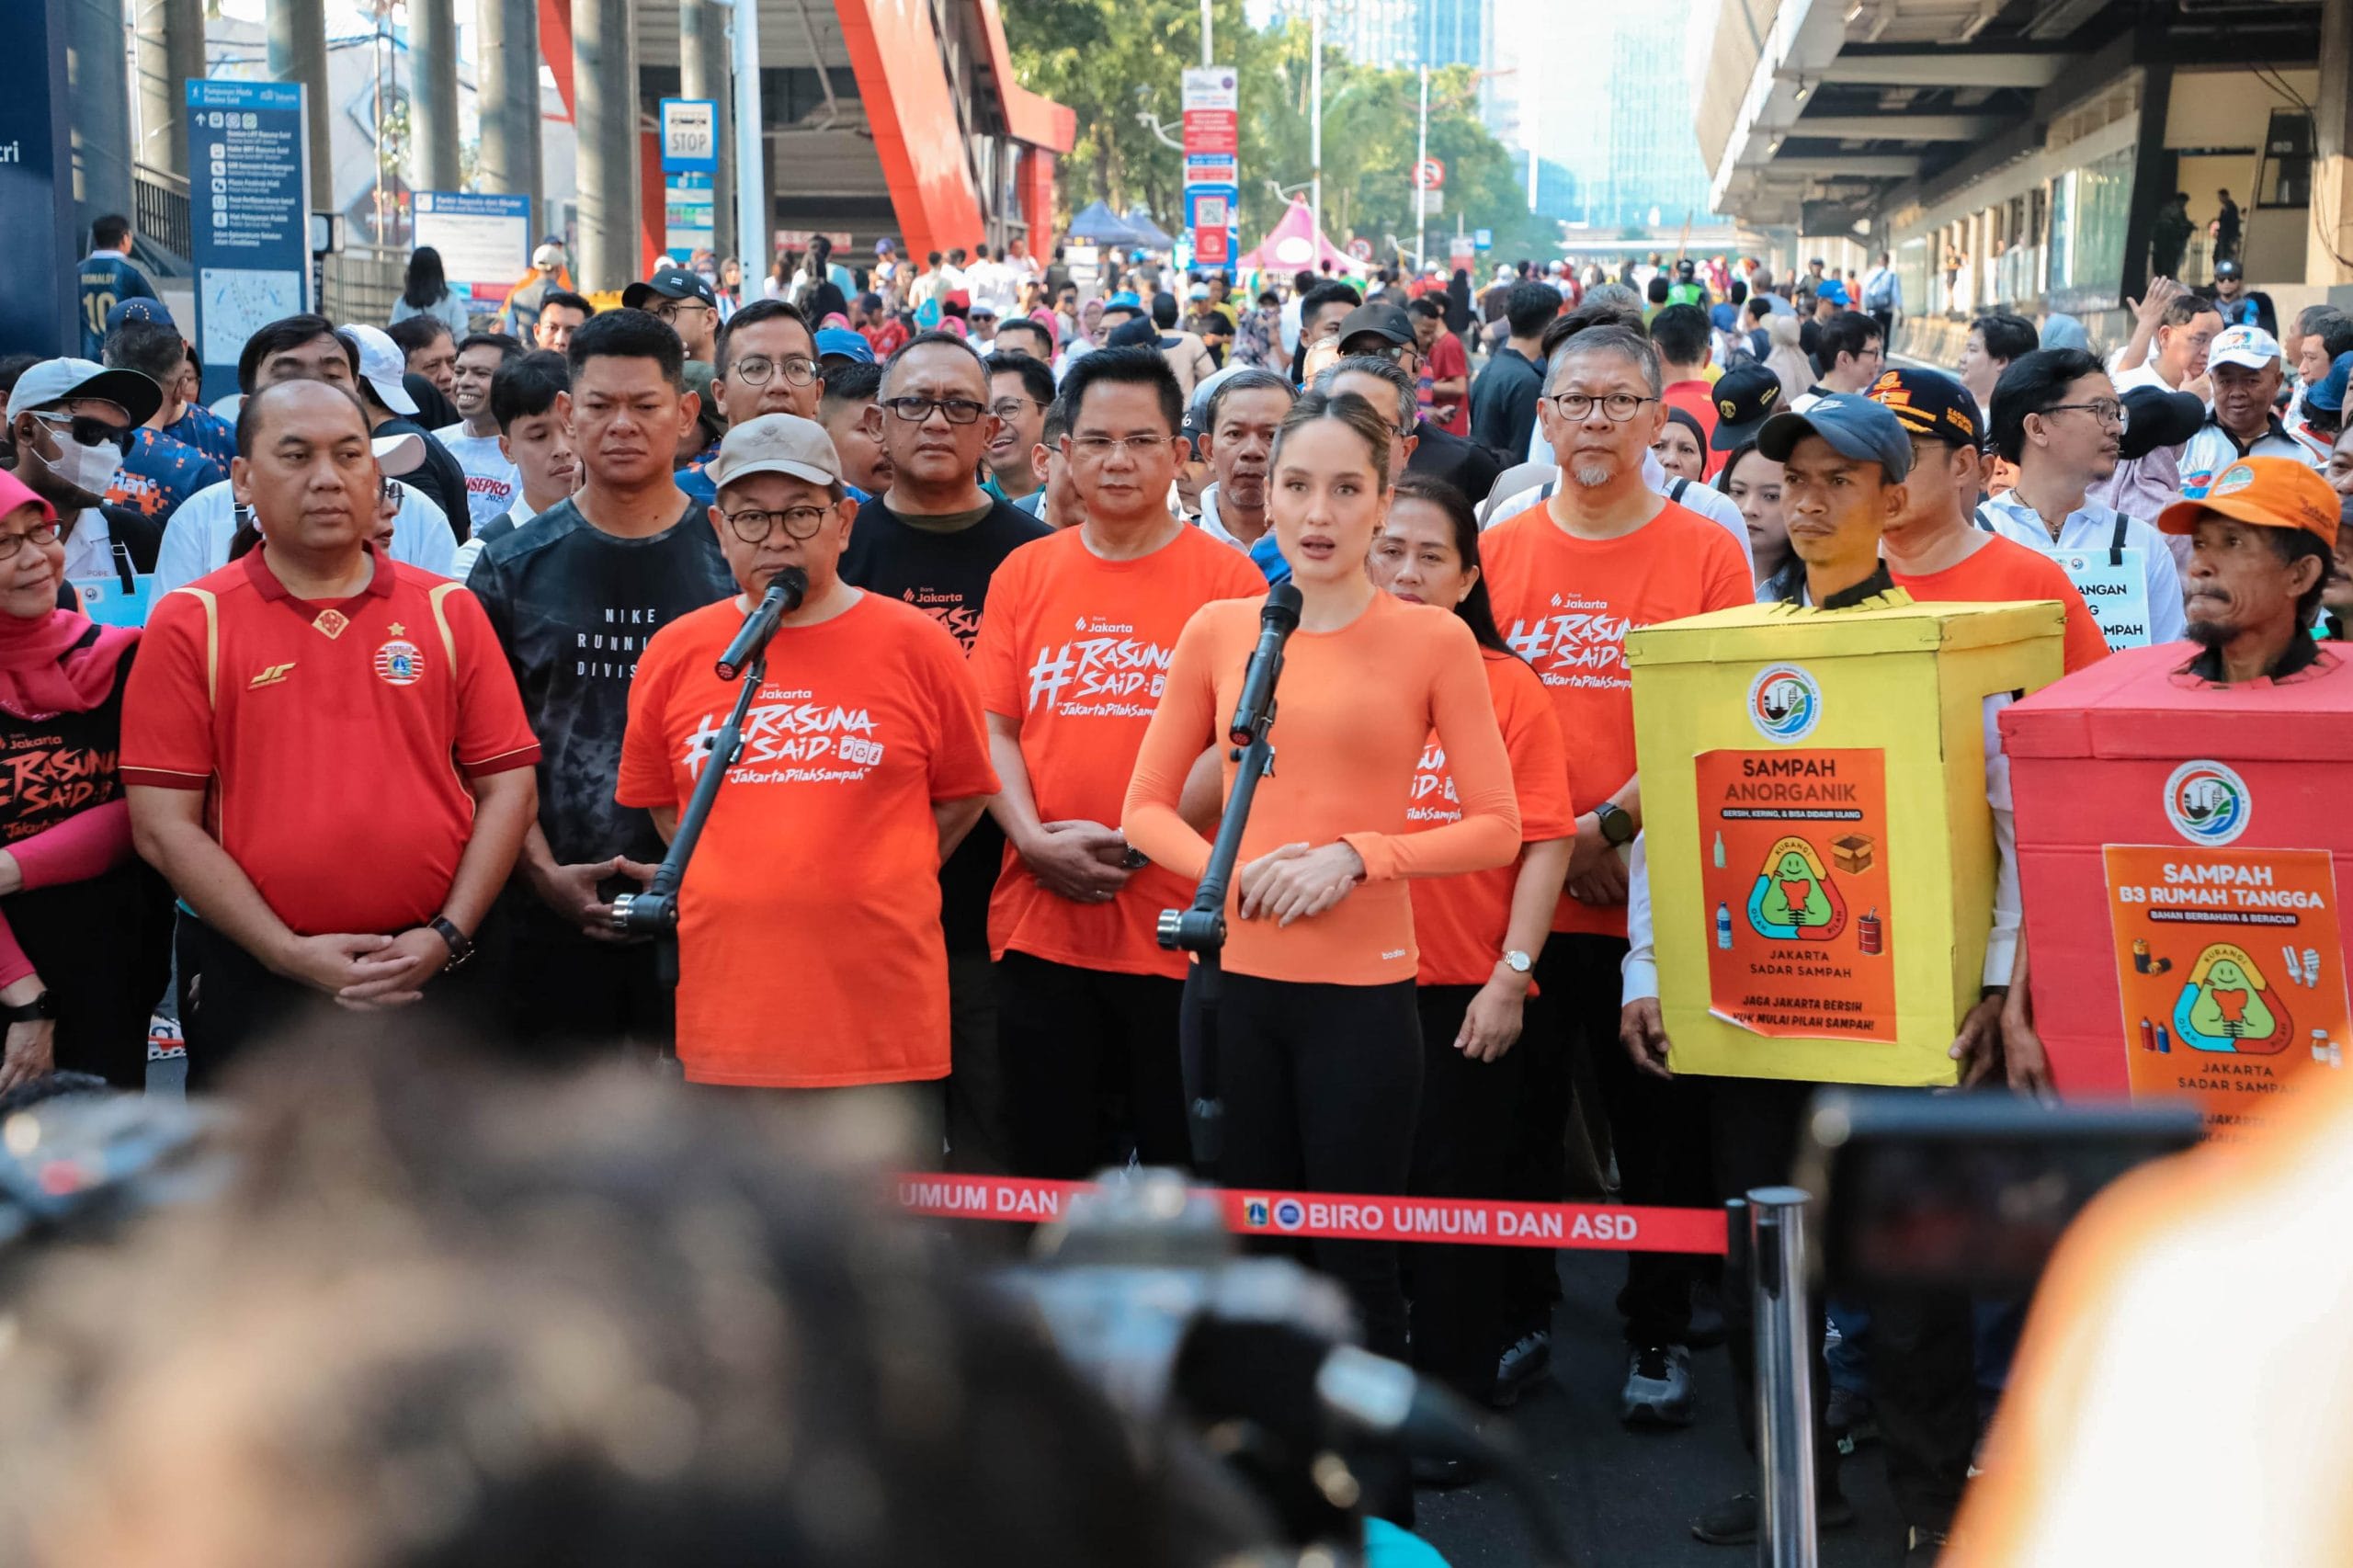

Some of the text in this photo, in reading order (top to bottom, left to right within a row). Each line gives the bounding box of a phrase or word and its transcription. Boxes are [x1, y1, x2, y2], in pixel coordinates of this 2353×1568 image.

[671, 133, 706, 151] STOP
[2078, 584, 2127, 596] ANGAN
[916, 594, 963, 603] Jakarta
[1563, 599, 1608, 609] Jakarta
[605, 608, 655, 623] NIKE
[1088, 622, 1133, 633] Jakarta
[2103, 624, 2143, 635] MPAH
[577, 633, 647, 651] RUNNI
[577, 662, 637, 678] DIVIS
[757, 689, 813, 699] Jakarta
[9, 736, 63, 750] Jakarta
[1743, 758, 1836, 778] SAMPAH
[1724, 783, 1857, 801] ANORGANIK
[1722, 810, 1750, 818] BERSIH,
[1807, 811, 1835, 819] DIDAUR
[1775, 842, 1812, 857] KURANGI
[2163, 863, 2273, 886] SAMPAH
[2120, 886, 2325, 909] B3 RUMAH TANGGA
[2151, 911, 2183, 920] BAHAN
[1769, 950, 1829, 961] JAKARTA
[1750, 964, 1852, 978] SADAR SAMPAH
[1743, 995, 1862, 1012] JAGA JAKARTA BERSIH
[1757, 1014, 1789, 1026] MULAI
[1791, 1015, 1823, 1028] PILAH
[1825, 1017, 1875, 1030] SAMPAH!
[2202, 1063, 2274, 1076] JAKARTA
[2178, 1077, 2230, 1090] SADAR
[899, 1183, 1059, 1215] UMUM DAN
[1309, 1202, 1637, 1242] BIRO UMUM DAN ASD
